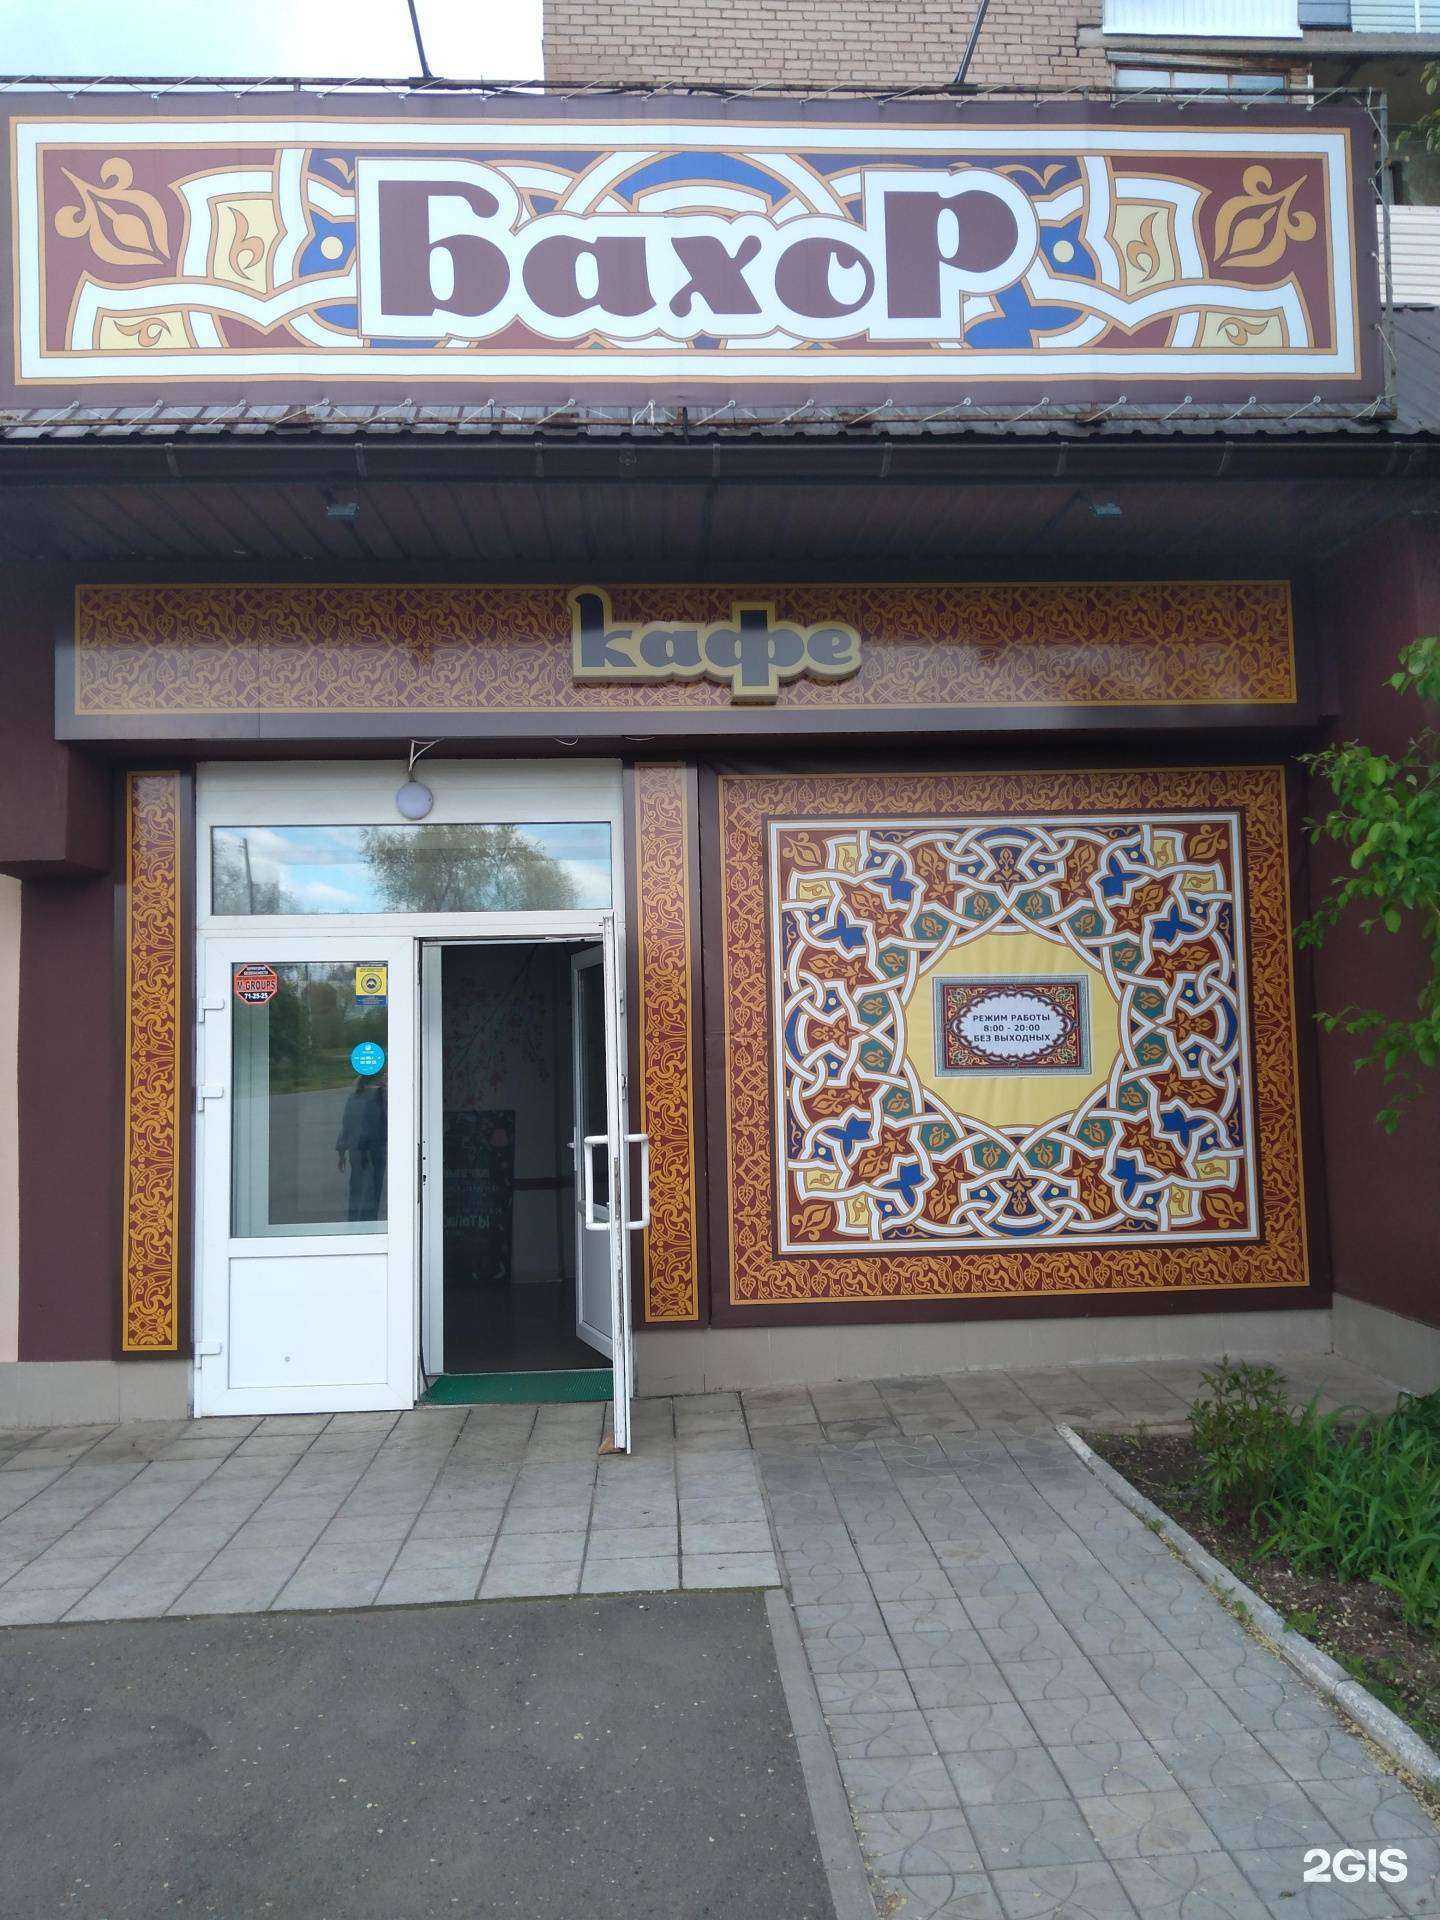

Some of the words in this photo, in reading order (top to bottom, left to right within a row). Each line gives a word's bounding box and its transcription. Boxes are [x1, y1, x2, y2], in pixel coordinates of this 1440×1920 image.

[973, 1014, 1008, 1022] РЕЖИМ
[1011, 1013, 1050, 1021] РАБОТЫ
[983, 1024, 1004, 1032] 8:00
[1014, 1024, 1041, 1032] 20:00
[974, 1034, 991, 1042] БЕЗ
[994, 1034, 1051, 1042] ВЫХОДНЫХ
